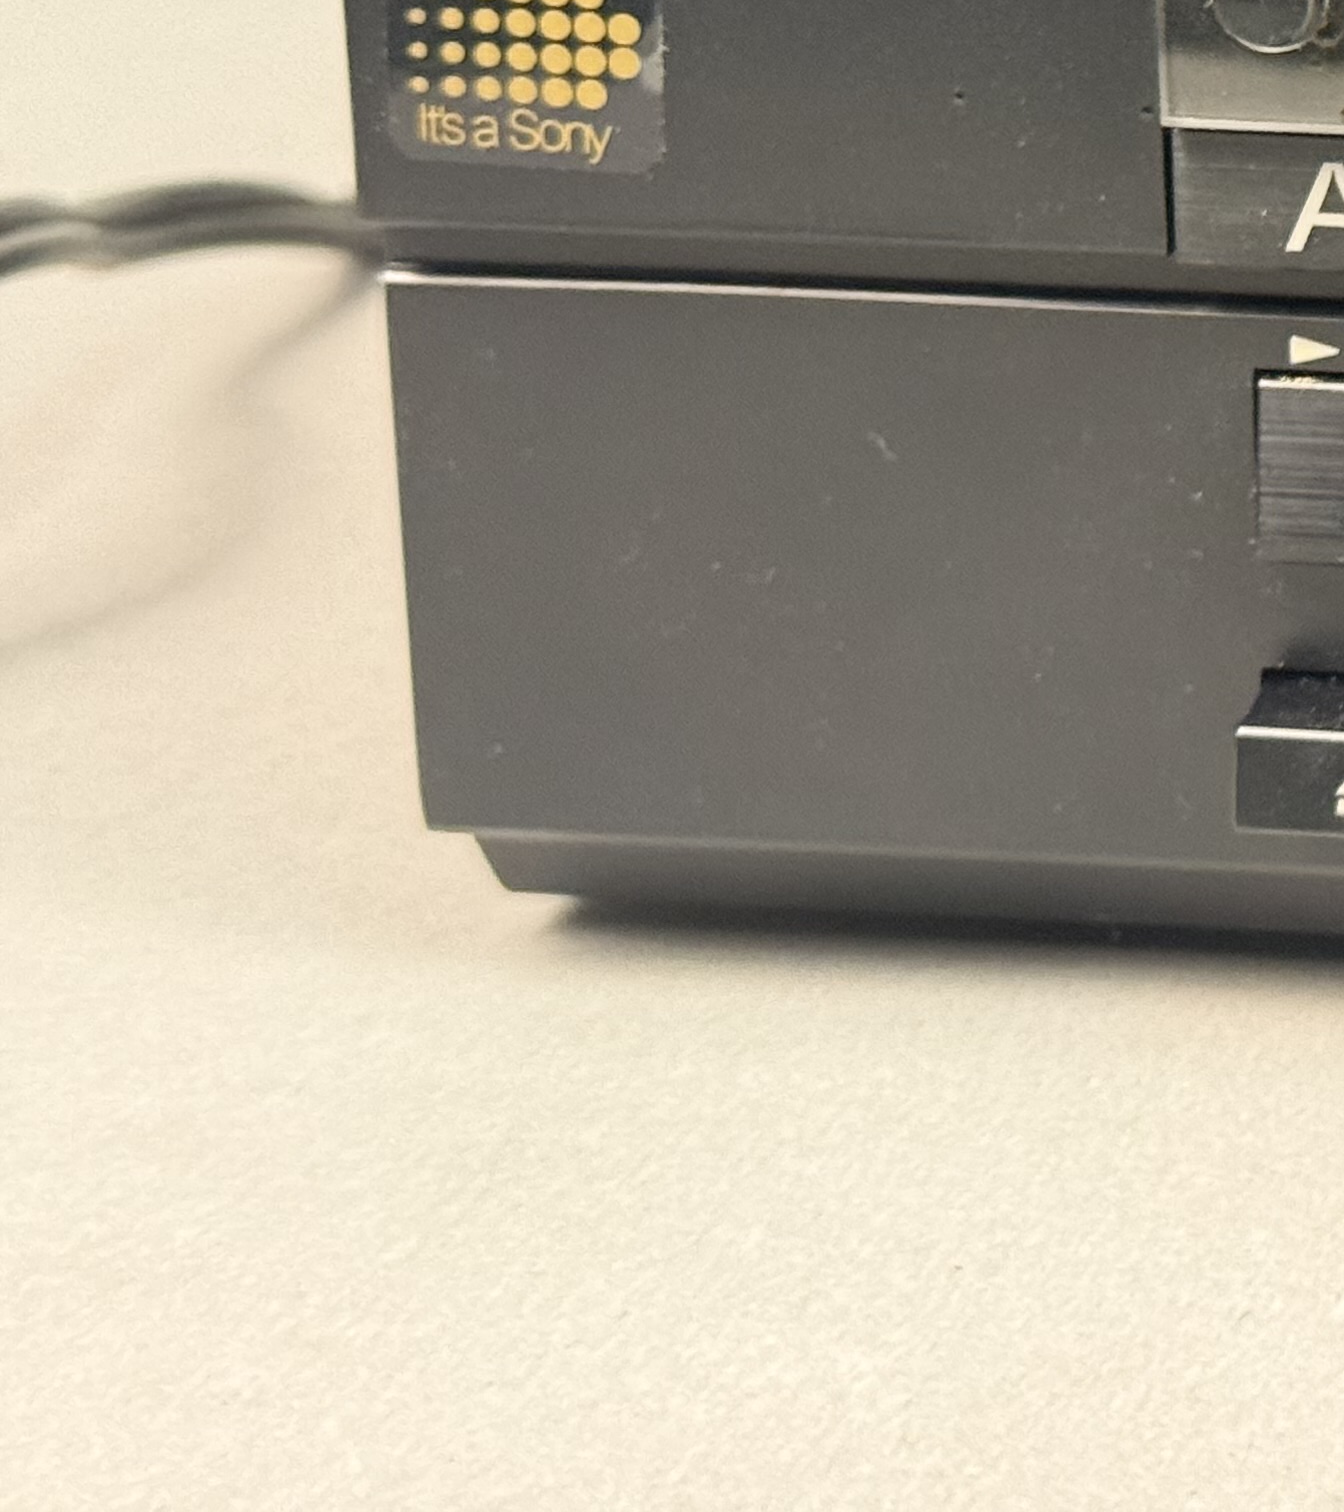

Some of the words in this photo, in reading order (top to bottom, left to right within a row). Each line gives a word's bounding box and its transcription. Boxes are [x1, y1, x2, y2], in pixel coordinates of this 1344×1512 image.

[417, 102, 467, 147] It's
[471, 114, 500, 149] a
[507, 106, 614, 164] Sony
